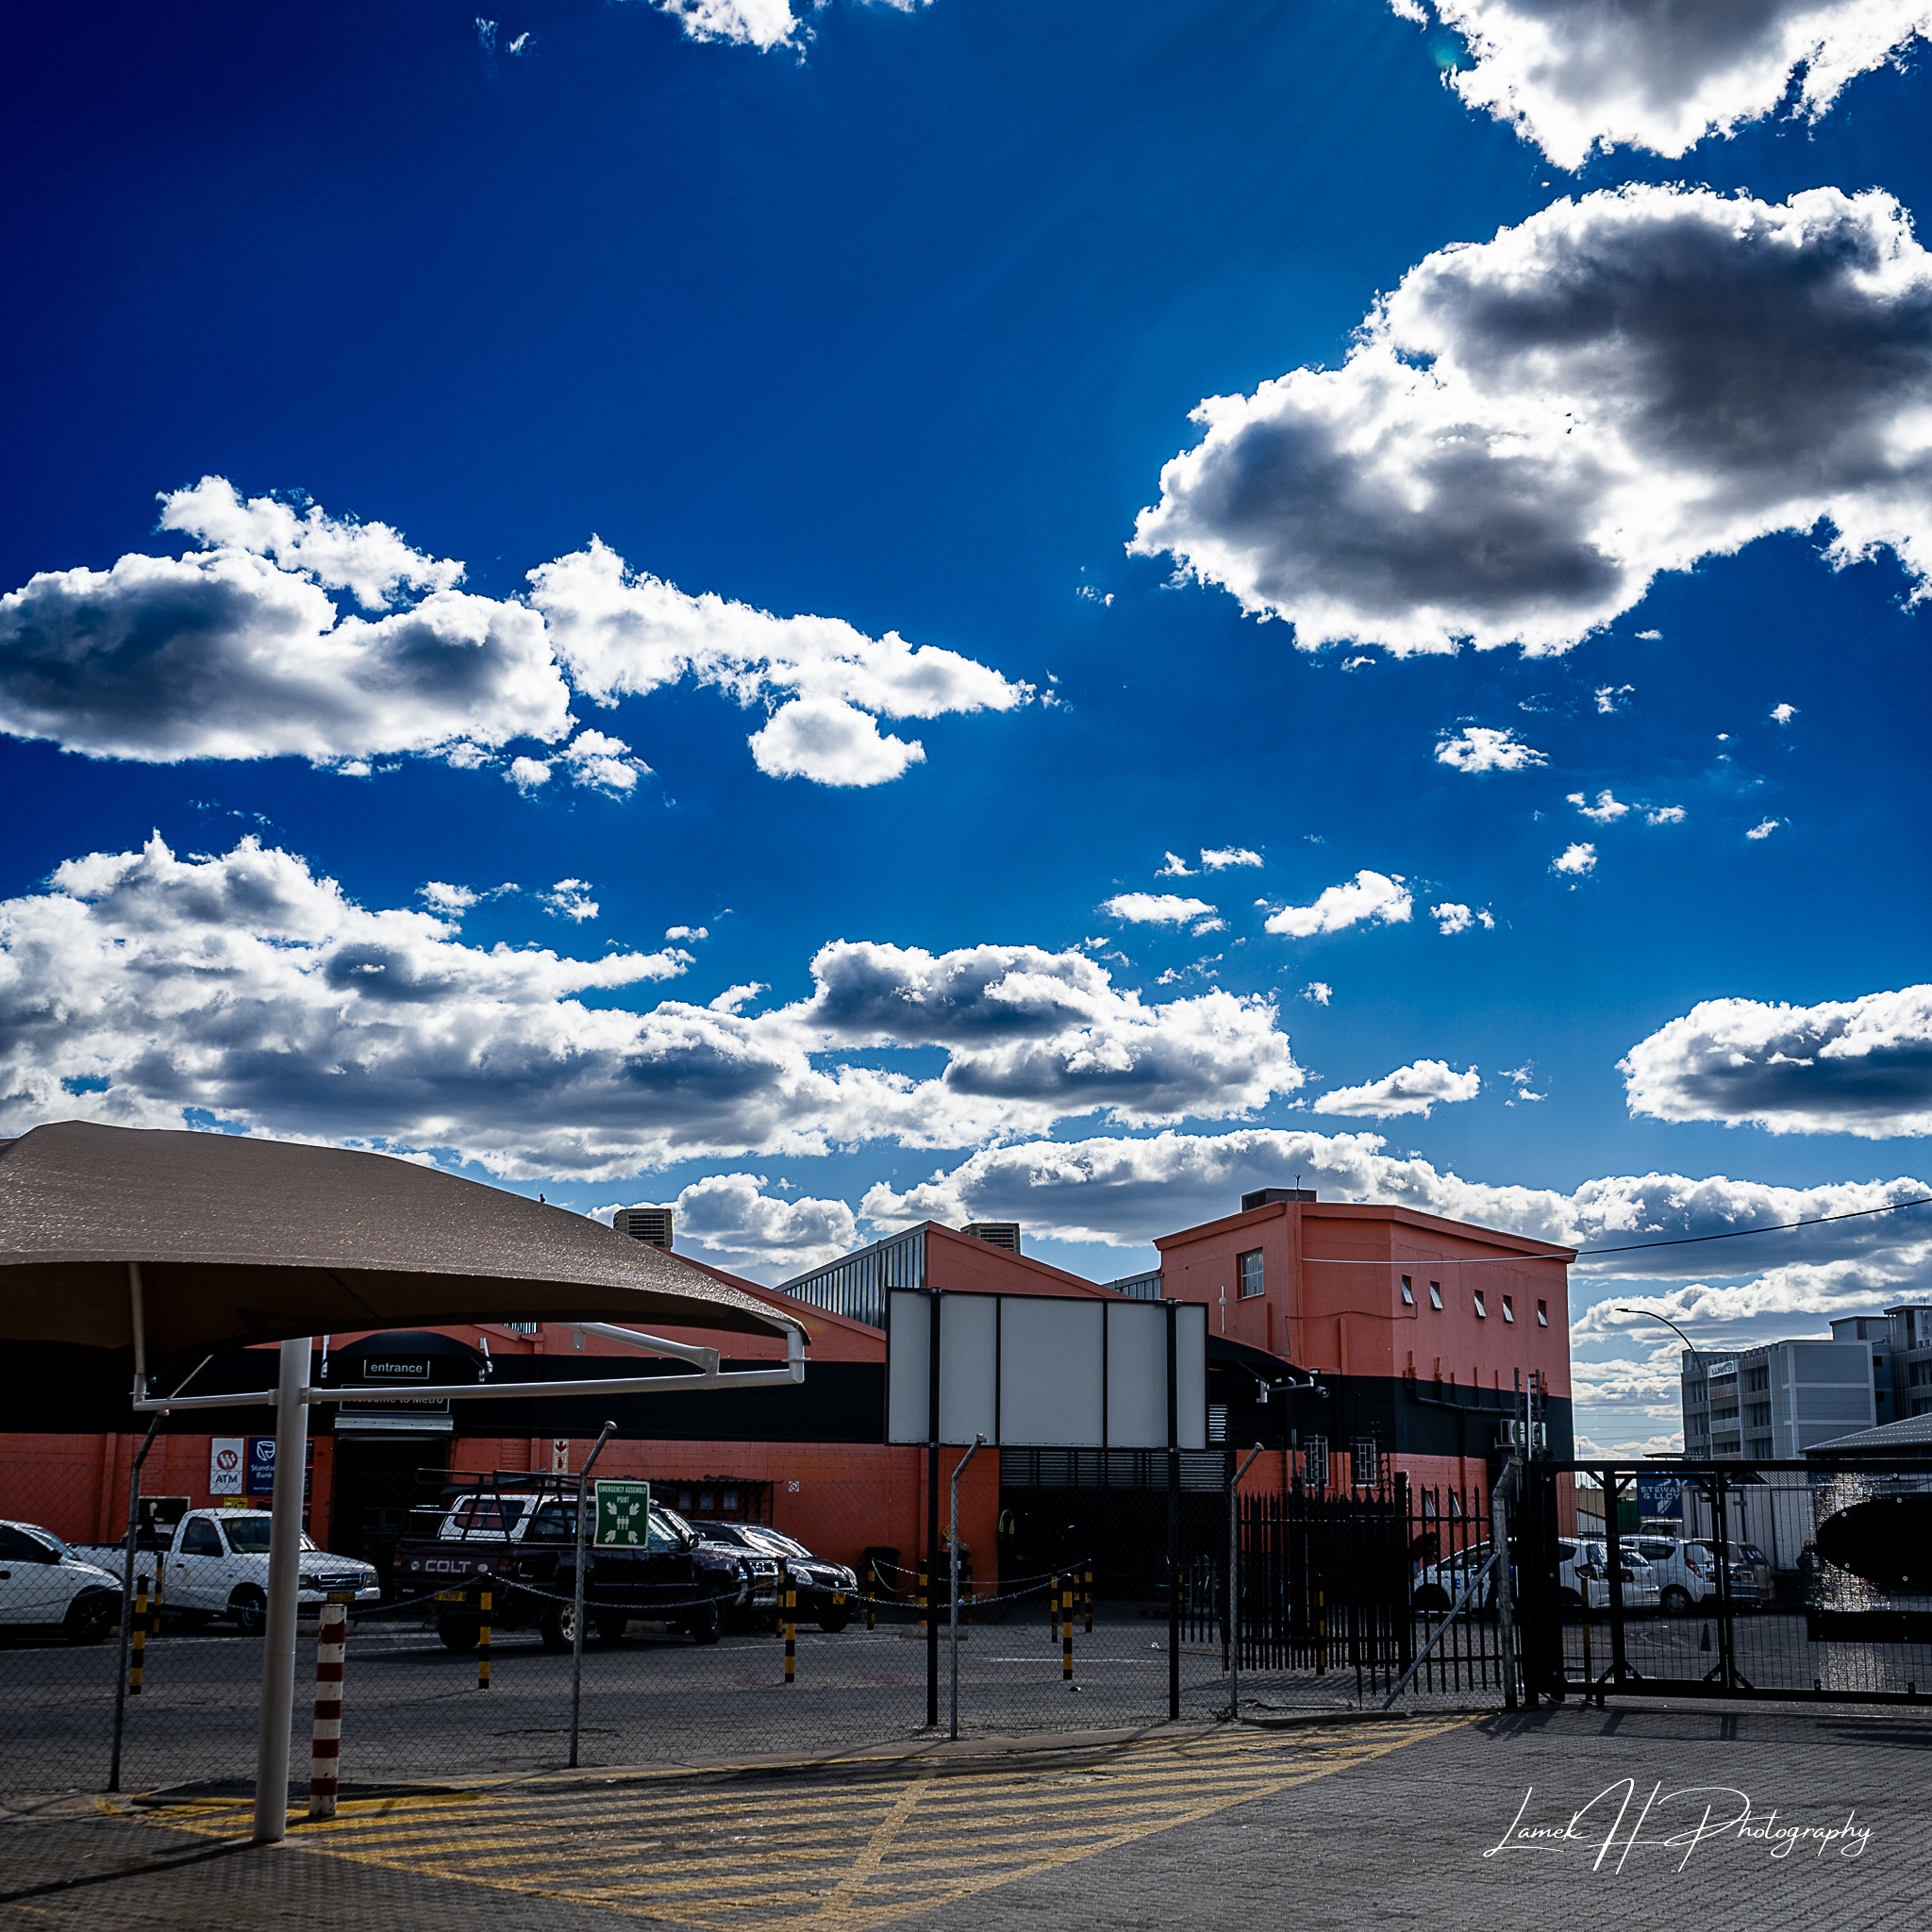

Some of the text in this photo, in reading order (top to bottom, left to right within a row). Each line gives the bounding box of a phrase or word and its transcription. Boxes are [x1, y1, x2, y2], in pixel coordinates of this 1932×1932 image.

[371, 1362, 423, 1373] entrance
[215, 1474, 238, 1483] ATM
[598, 1485, 646, 1494] EMERGENCY ASSEMBLY
[425, 1559, 472, 1573] COLT
